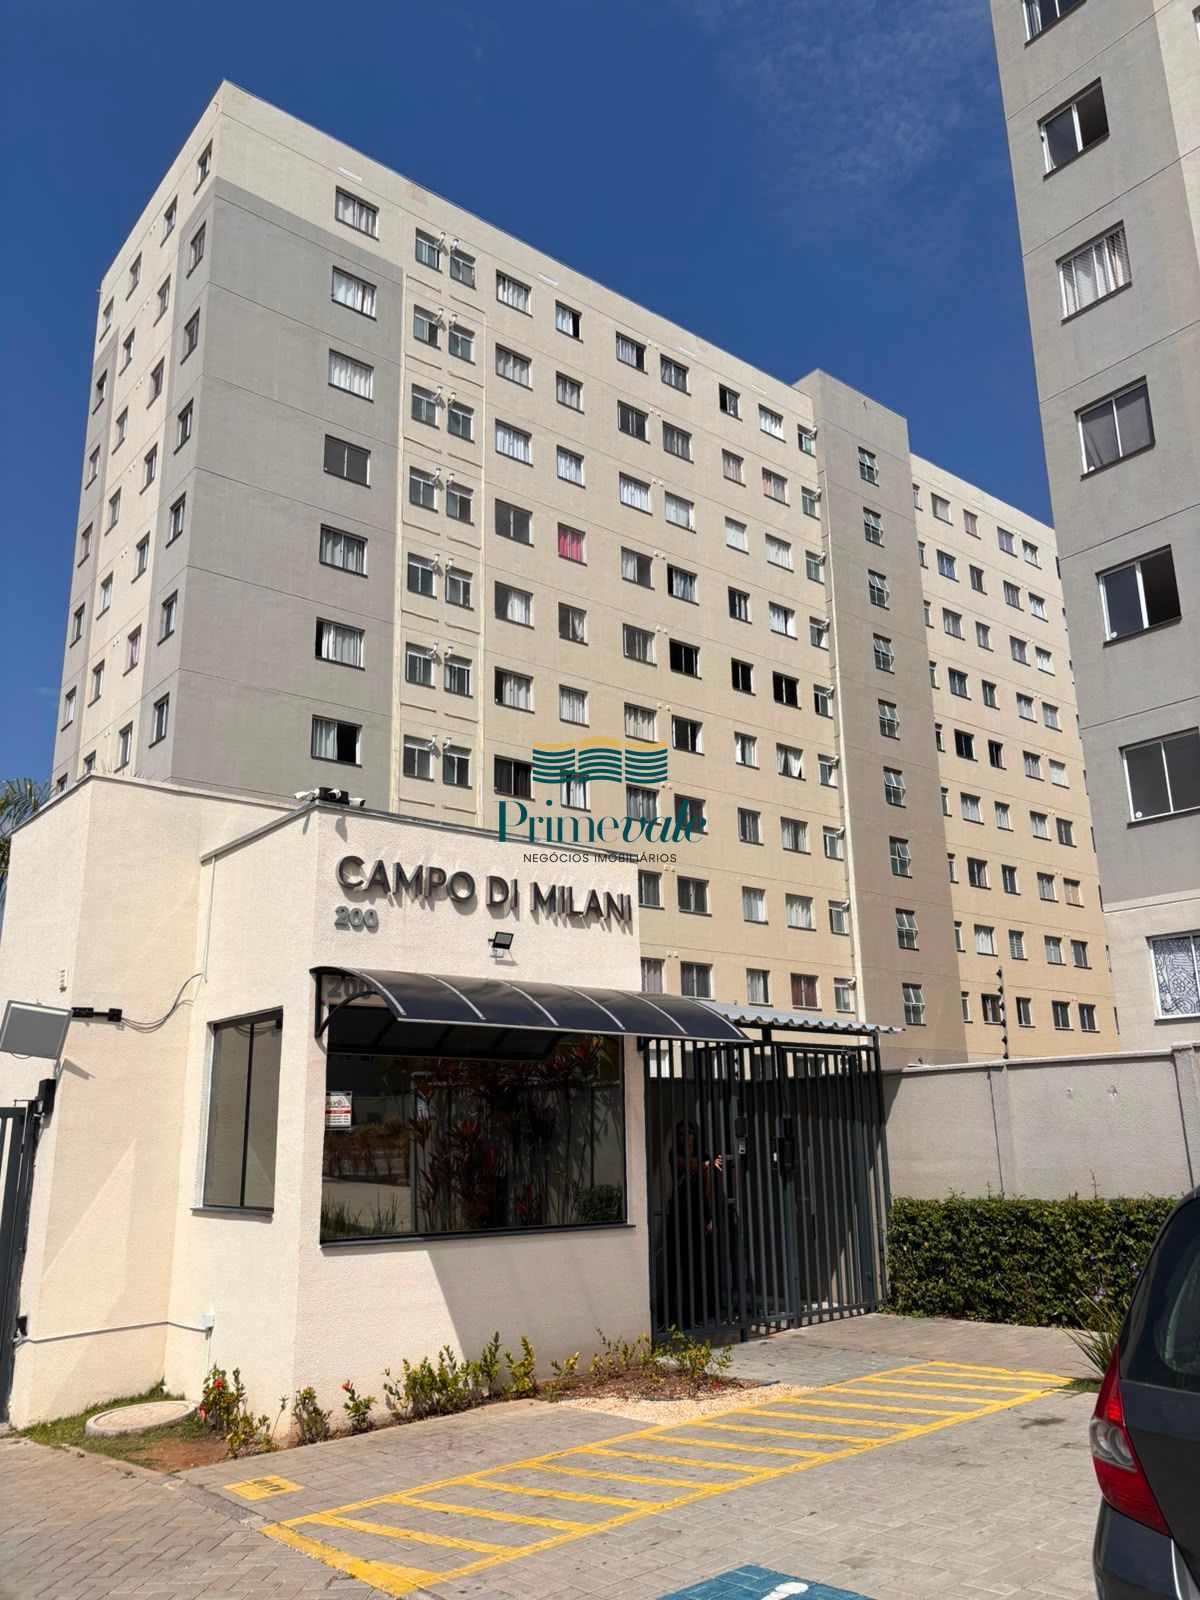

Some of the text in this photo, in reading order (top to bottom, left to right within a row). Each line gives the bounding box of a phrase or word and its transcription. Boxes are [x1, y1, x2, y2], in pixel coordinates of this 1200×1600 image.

[336, 855, 632, 923] CAMPO DI MILANI
[334, 905, 379, 932] 200
